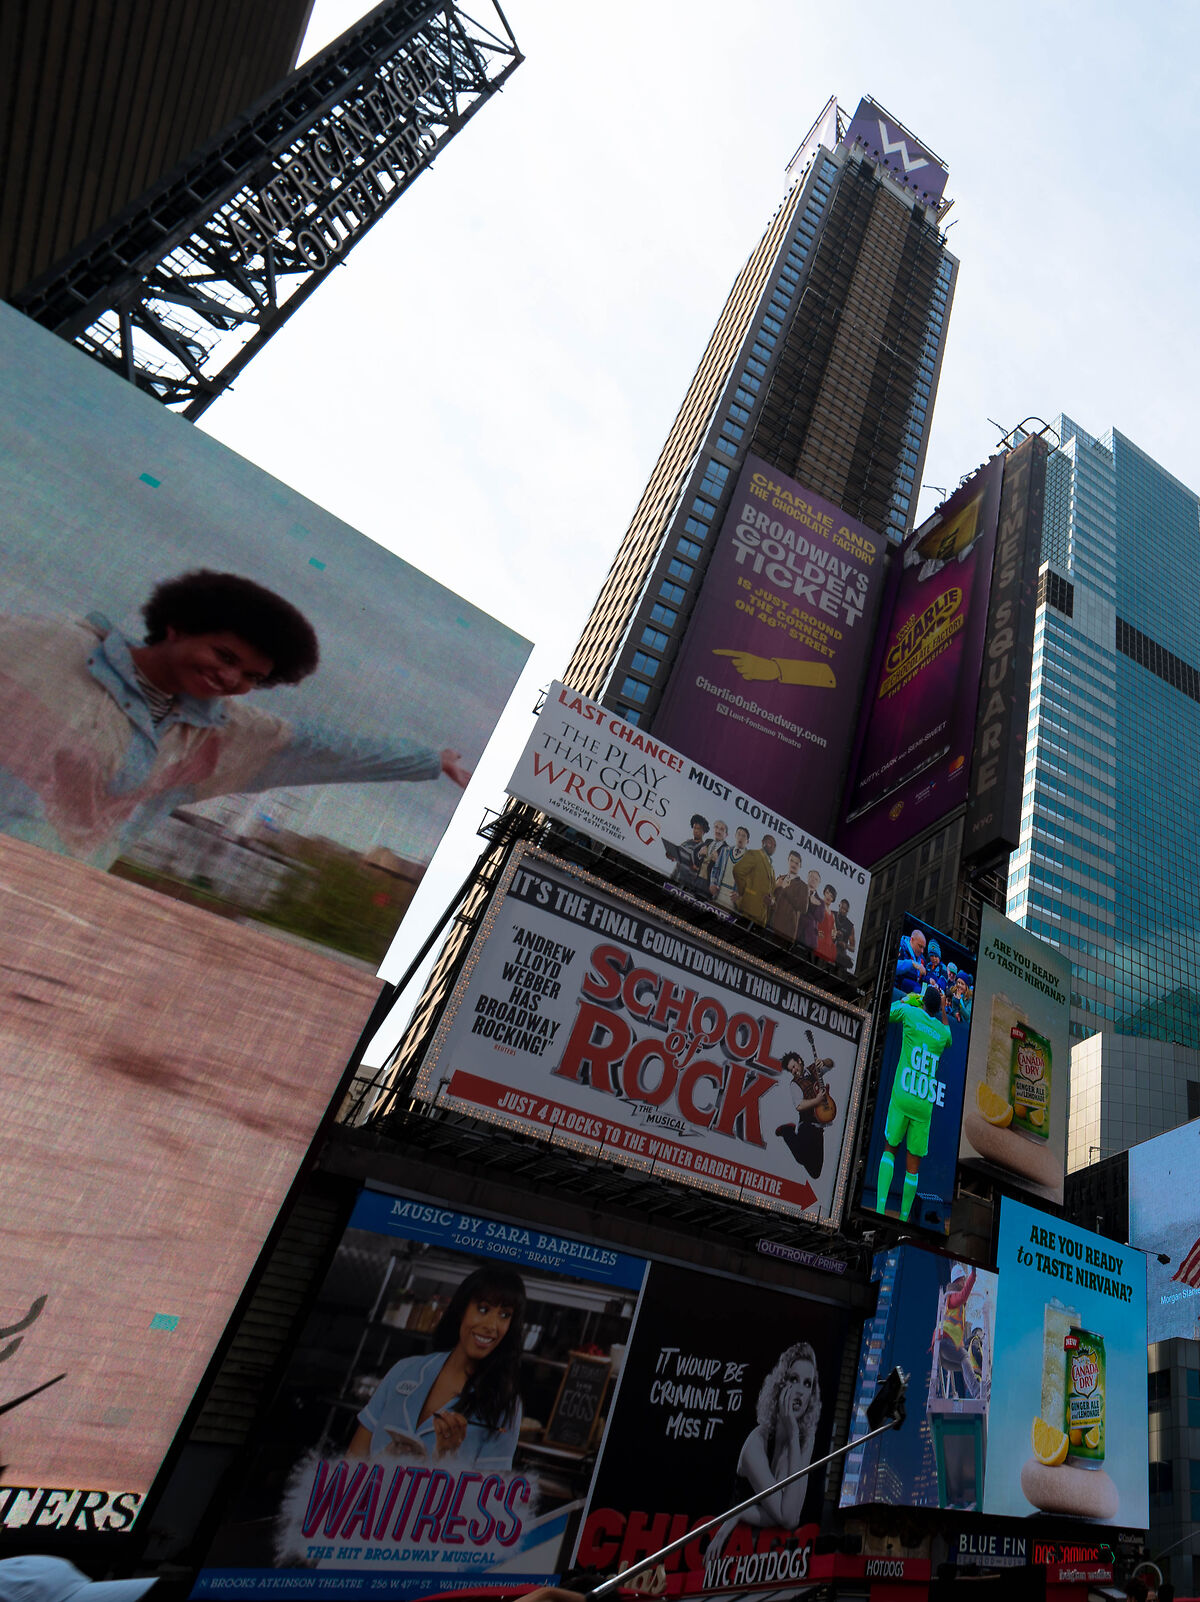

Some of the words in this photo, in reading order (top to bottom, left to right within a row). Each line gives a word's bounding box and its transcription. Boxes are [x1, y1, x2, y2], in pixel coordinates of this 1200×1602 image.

[228, 106, 376, 264] AMERICAN
[365, 46, 440, 132] EAGLE
[878, 118, 929, 172] W
[298, 115, 438, 270] OUTFITTERS
[750, 482, 769, 501] THE
[772, 497, 830, 539] CHOCOLATE
[832, 535, 875, 566] FACTORY
[752, 472, 834, 529] CHARLIE
[838, 528, 877, 554] AND
[999, 463, 1028, 590] TIMES
[735, 523, 866, 611] GOLDEN
[740, 503, 870, 592] BROADWAY'S
[732, 538, 862, 627] TICKET
[735, 599, 754, 616] ON
[788, 629, 837, 659] STREET
[737, 576, 753, 591] IS
[754, 588, 790, 610] JUST
[791, 603, 843, 641] AROUND
[749, 595, 774, 615] THE
[776, 608, 828, 644] CORNER
[887, 588, 960, 670] CHARLIE
[695, 675, 827, 748] CharlieOnBroadway.com
[976, 600, 1013, 796] SQUARE
[543, 732, 598, 772] THAT
[600, 767, 670, 818] GOES
[562, 721, 600, 754] THE
[604, 744, 667, 789] PLAY
[533, 751, 660, 846] WRONG
[558, 689, 607, 726] LAST
[608, 720, 684, 774] CHANCE!
[688, 766, 732, 801] MUST
[735, 796, 795, 841] CLOTHES
[797, 834, 857, 880] JANUARY
[857, 871, 866, 886] 6
[972, 814, 993, 832] NYC
[510, 870, 553, 904] IT'S
[554, 887, 591, 922] THE
[589, 903, 638, 944] FINAL
[641, 927, 743, 988] COUNTDOWN!
[745, 973, 780, 1005] THRU
[781, 991, 808, 1017] JAN
[811, 1003, 828, 1025] 20
[829, 1010, 860, 1039] ONLY
[515, 948, 562, 979] LLOYD
[984, 947, 995, 960] to
[996, 953, 1023, 981] TASTE
[1024, 972, 1066, 1005] NIRVANA?
[993, 937, 1013, 957] ARE
[1010, 947, 1031, 969] YOU
[1031, 958, 1061, 988] READY
[502, 962, 561, 1000] WEBBER
[509, 986, 542, 1012] HAS
[474, 994, 561, 1040] BROADWAY
[581, 943, 783, 1074] SCHOOL
[550, 997, 779, 1150] ROCK
[664, 1031, 710, 1069] of
[911, 1047, 940, 1077] GET
[1018, 1053, 1044, 1066] CANADA
[1026, 1065, 1039, 1075] DRY
[900, 1070, 946, 1107] CLOSE
[498, 1092, 537, 1114] JUST
[538, 1104, 550, 1120] 4
[549, 1107, 603, 1137] BLOCKS
[604, 1124, 621, 1141] TO
[622, 1131, 647, 1151] THE
[648, 1139, 692, 1166] WINTER
[693, 1152, 738, 1181] GARDEN
[739, 1166, 783, 1196] THEATRE
[646, 1114, 686, 1130] MUSICAL
[391, 1200, 454, 1226] MUSIC
[459, 1216, 484, 1233] BY
[485, 1221, 531, 1246] SARA
[536, 1236, 617, 1266] BAREILLES
[451, 1232, 485, 1249] "LOVE
[525, 1250, 565, 1267] "BRAVE"
[760, 1242, 814, 1265] OUTFRONT
[1030, 1224, 1055, 1250] ARE
[1058, 1236, 1083, 1260] YOU
[1085, 1248, 1123, 1275] READY
[1017, 1245, 1033, 1267] to
[1036, 1254, 1074, 1283] TASTE
[1076, 1268, 1133, 1303] NIRVANA?
[655, 1347, 681, 1374] IT
[676, 1354, 722, 1381] WOULD
[723, 1361, 750, 1383] BE
[1066, 1338, 1077, 1346] NEW
[650, 1380, 723, 1412] CRIMINAL
[726, 1388, 743, 1412] TO
[1072, 1363, 1099, 1382] CANADA
[1079, 1375, 1093, 1389] DRY
[665, 1411, 701, 1440] MISS
[703, 1417, 724, 1441] IT
[1071, 1401, 1090, 1411] GINGER
[302, 1459, 531, 1547] WAITRESS
[306, 1546, 334, 1559] THE
[336, 1547, 361, 1560] HIT
[364, 1548, 438, 1562] BROADWAY
[441, 1551, 496, 1563] MUSICAL
[703, 1556, 736, 1588] NYC
[735, 1546, 810, 1585] HOTDOGS
[866, 1559, 904, 1577] HOTDOGS
[959, 1533, 997, 1555] BLUE
[1003, 1537, 1026, 1555] FIN
[210, 1579, 256, 1588] BROOKS
[258, 1579, 315, 1588] ATKINSON
[318, 1579, 363, 1589] THEATRE
[390, 1580, 400, 1589] W
